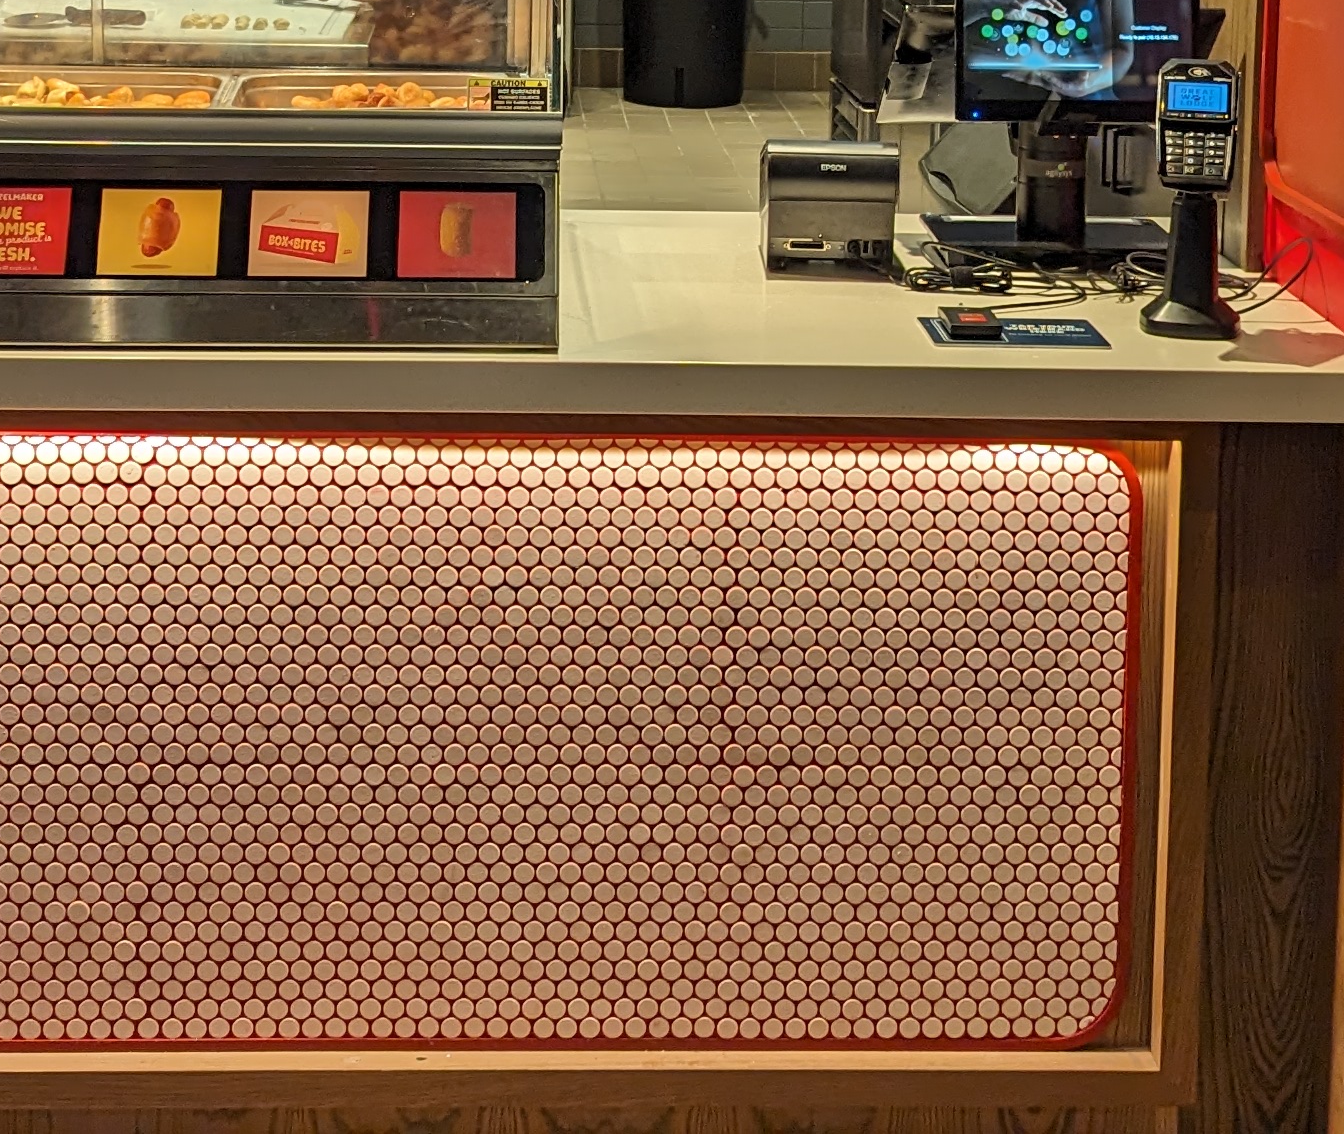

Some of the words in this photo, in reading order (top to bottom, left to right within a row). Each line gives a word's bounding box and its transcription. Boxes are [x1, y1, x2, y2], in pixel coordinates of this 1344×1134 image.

[820, 164, 847, 172] EPSON
[6, 235, 42, 247] product
[268, 234, 288, 246] BOX
[294, 237, 326, 253] BITES
